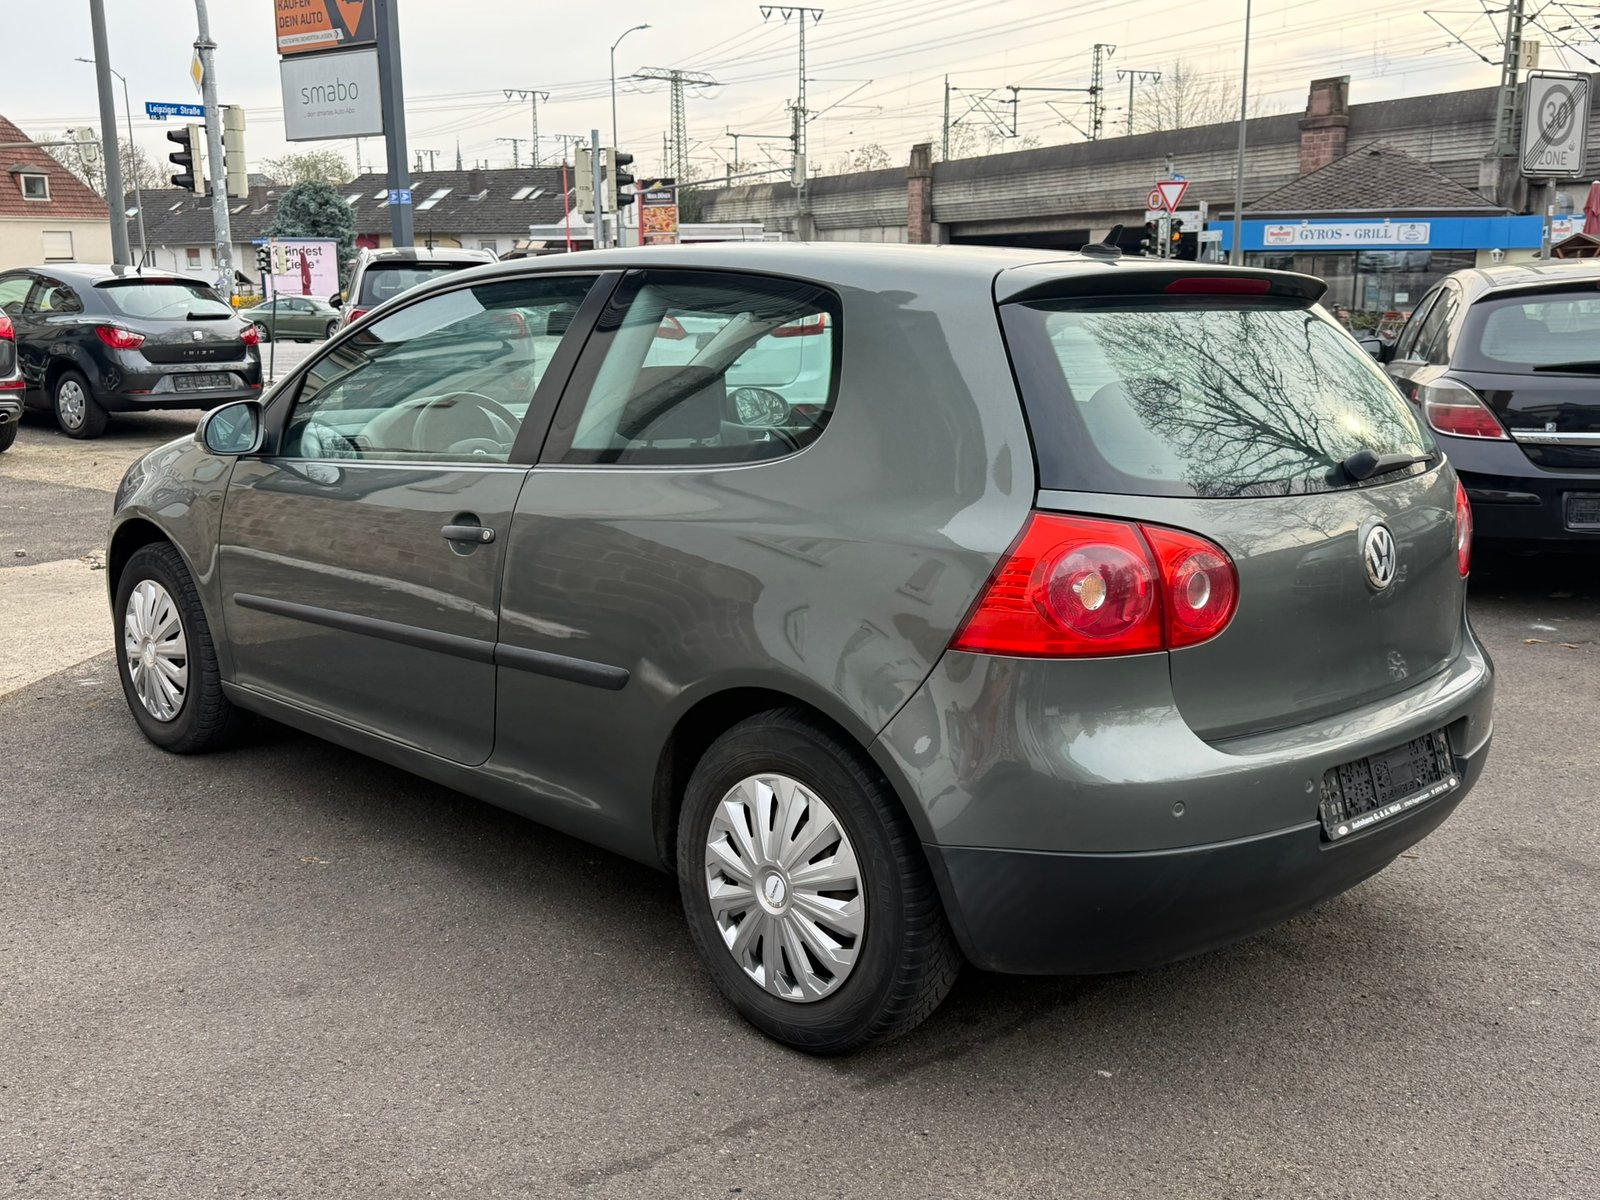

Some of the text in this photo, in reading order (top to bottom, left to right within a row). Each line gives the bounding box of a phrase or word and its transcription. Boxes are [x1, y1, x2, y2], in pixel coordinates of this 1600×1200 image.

[279, 11, 323, 28] DEIN AUTO
[1526, 55, 1533, 67] 2
[301, 77, 359, 105] smabo
[149, 103, 201, 116] Leipziger Straße
[1538, 150, 1567, 166] ZONE
[1300, 228, 1342, 241] GYROS
[1354, 227, 1392, 240] GRILL
